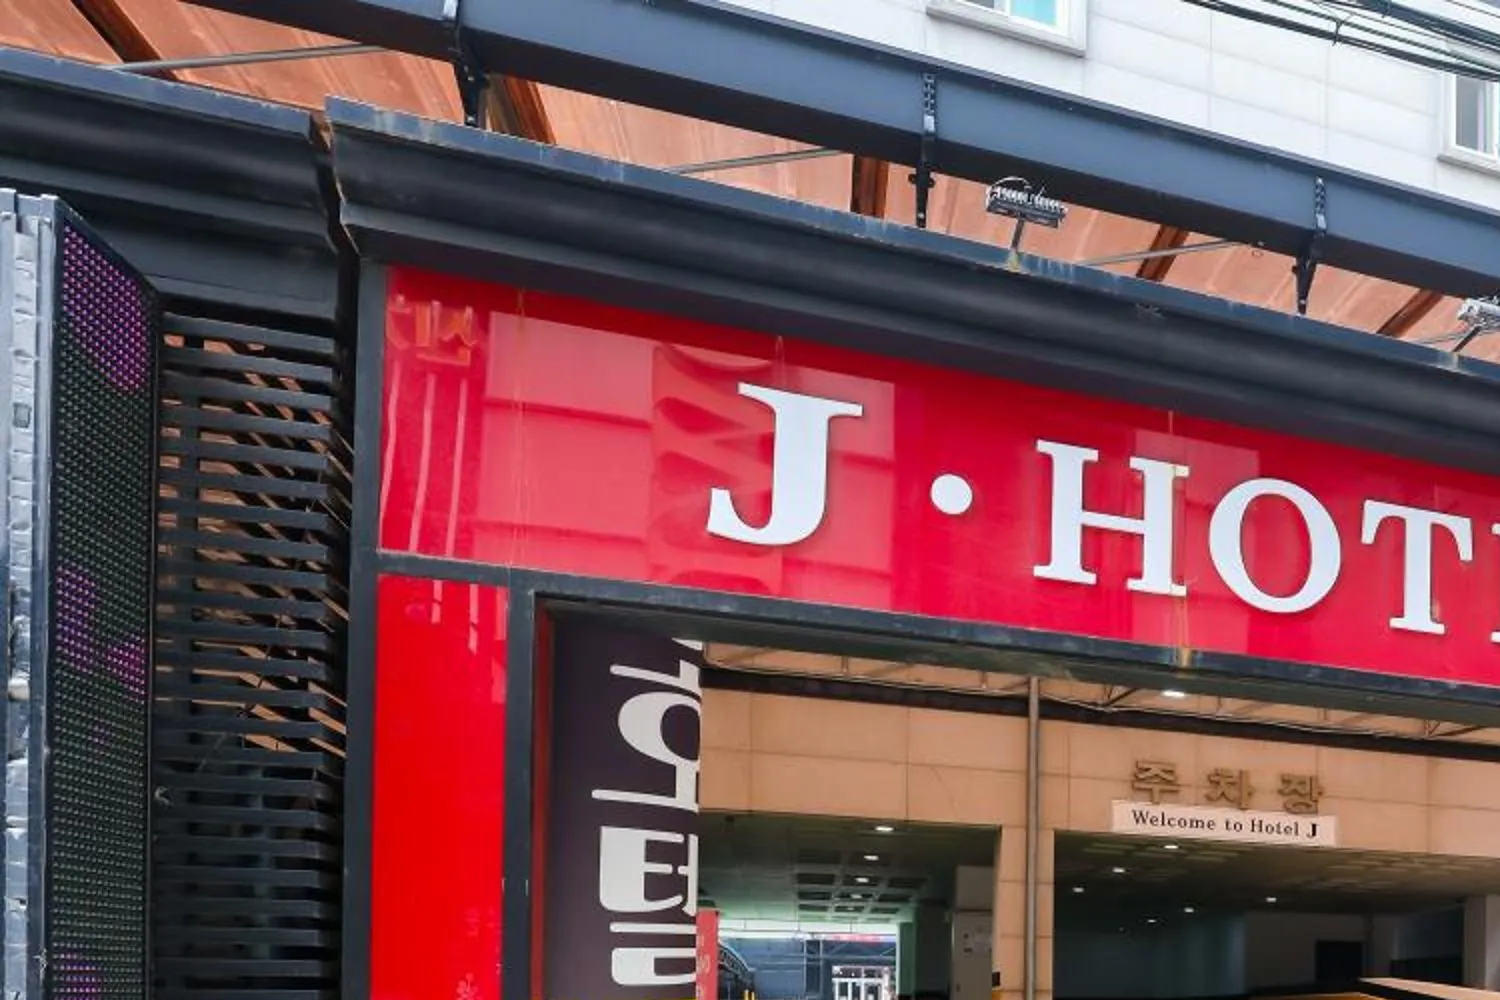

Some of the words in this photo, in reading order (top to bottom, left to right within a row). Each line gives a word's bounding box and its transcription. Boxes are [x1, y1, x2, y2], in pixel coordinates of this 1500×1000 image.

[706, 382, 863, 545] J
[1131, 760, 1325, 814] 주차장
[1131, 809, 1216, 831] Welcome
[1225, 816, 1243, 833] to
[1250, 819, 1299, 837] Hotel
[1306, 823, 1320, 839] J
